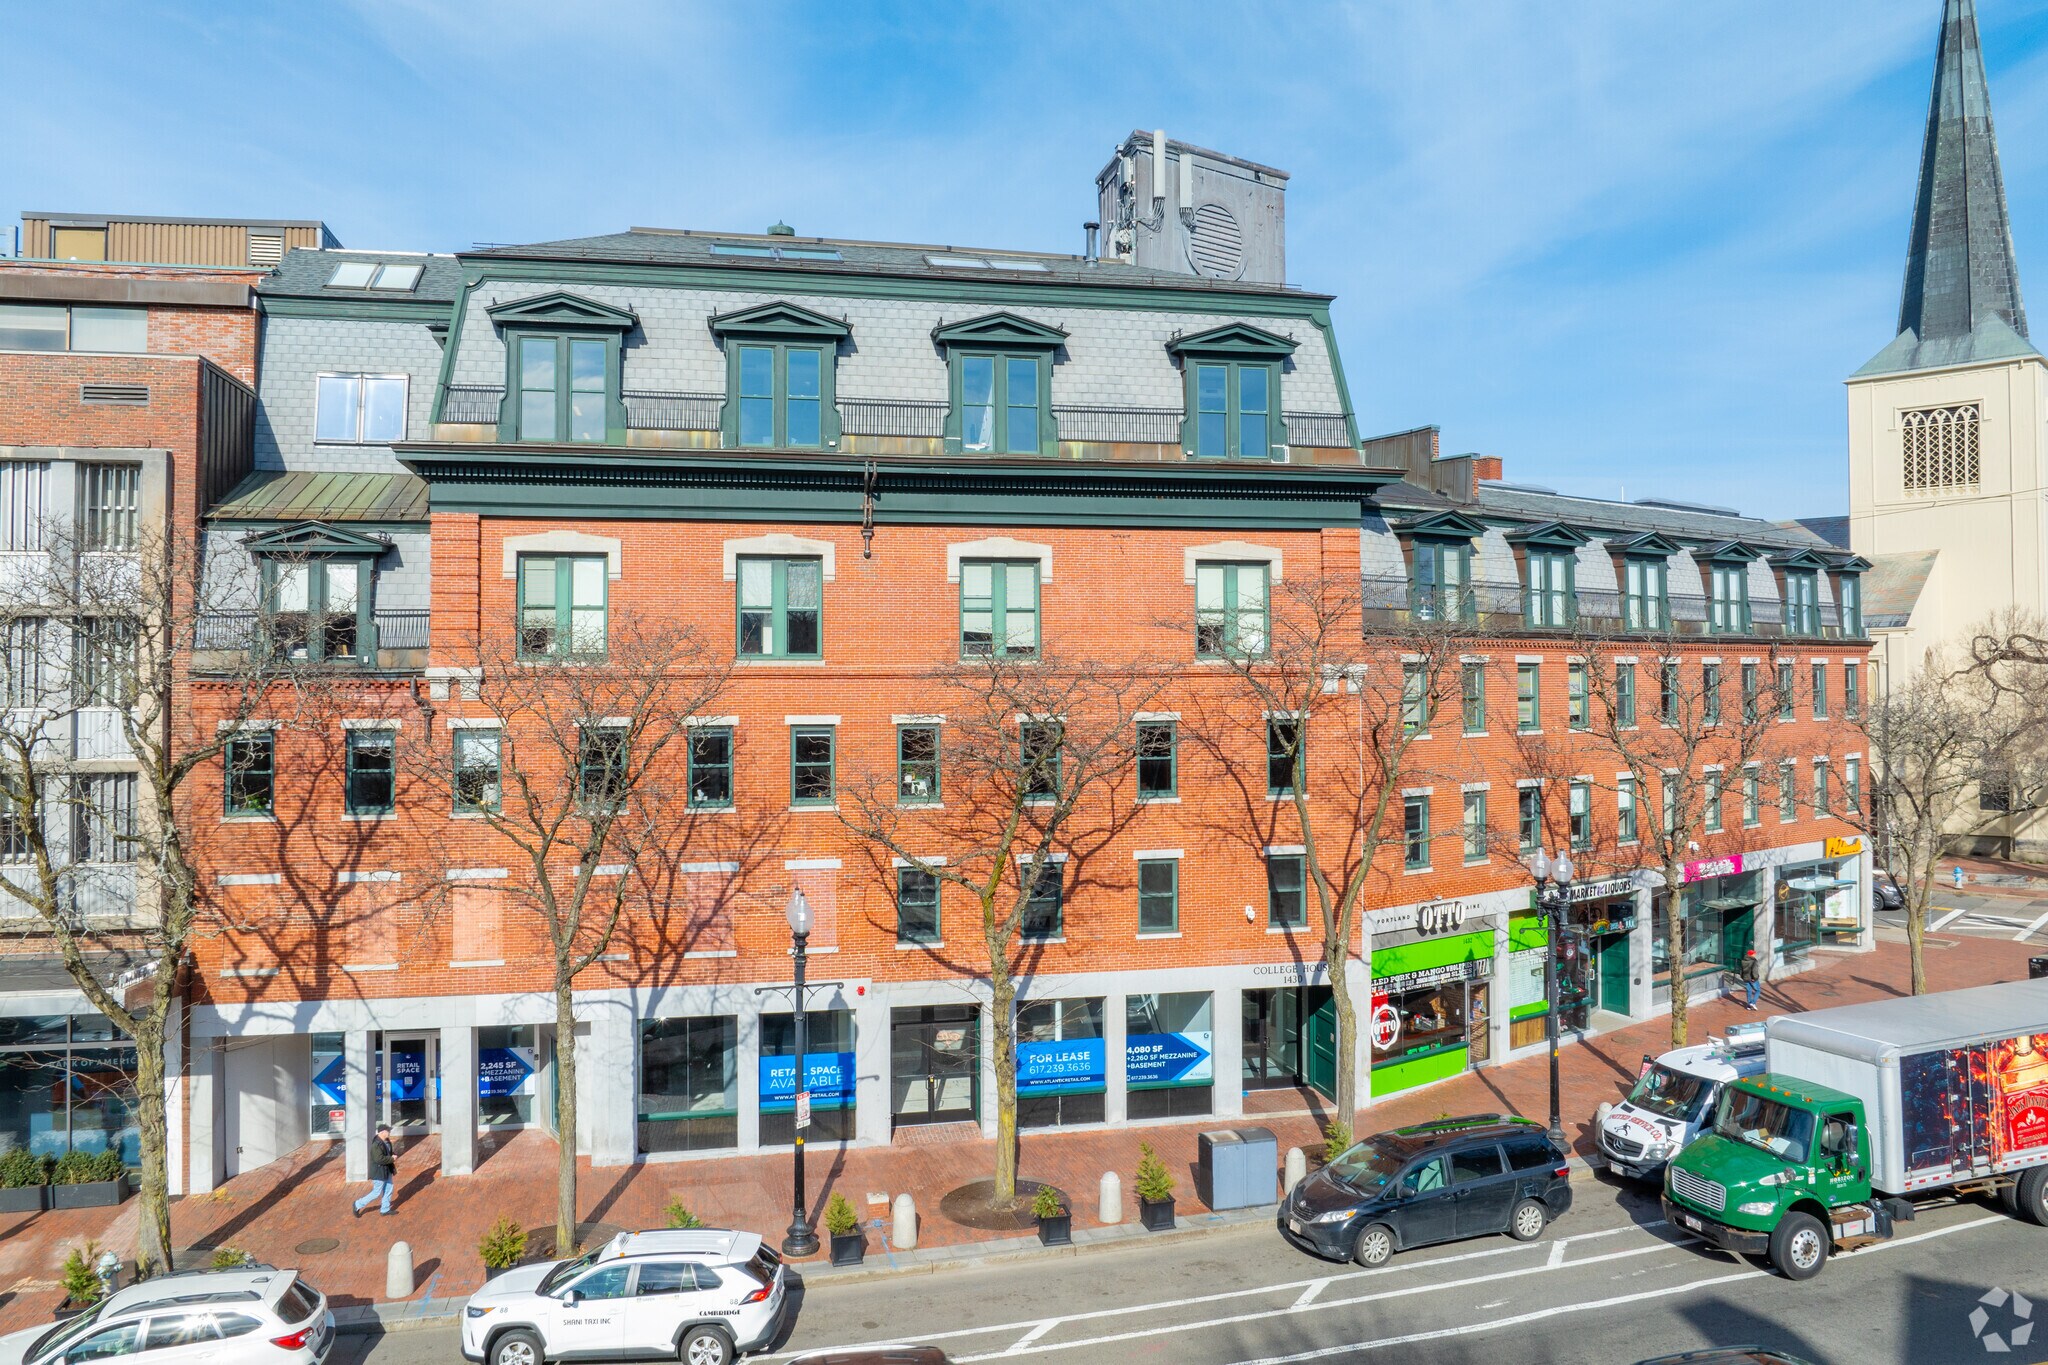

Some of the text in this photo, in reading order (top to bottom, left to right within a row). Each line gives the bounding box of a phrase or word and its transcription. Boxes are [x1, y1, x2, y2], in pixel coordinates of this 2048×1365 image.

[1569, 886, 1597, 900] MARKET
[1604, 880, 1631, 895] LIQUORS
[1377, 914, 1411, 924] PORTLAND
[1419, 902, 1465, 931] OTTO
[1253, 963, 1328, 975] COLLEGE HOUS
[1284, 974, 1303, 984] 1430
[1374, 1020, 1396, 1035] OTTO
[1127, 1045, 1163, 1055] 4,080 SF
[81, 1059, 94, 1067] OF
[96, 1055, 138, 1067] AMERIC
[1030, 1051, 1091, 1064] FOR LEASE
[1160, 1052, 1198, 1060] MEZZANINE
[480, 1061, 517, 1070] 2,245 SF
[1029, 1062, 1091, 1075] 617.239.3636
[1126, 1061, 1166, 1069] +BASEMENT
[770, 1066, 844, 1077] RETA SPACE
[770, 1075, 844, 1089] AVAABLE
[1030, 1076, 1091, 1085] WWW.ATLANTICRETAIL.COM
[1629, 1117, 1655, 1132] SERVICE
[1829, 1174, 1855, 1184] HORIZON
[499, 1306, 509, 1314] 88
[699, 1309, 741, 1317] CAMBRIDGE
[563, 1318, 583, 1326] SHANI
[600, 1317, 612, 1325] INC
